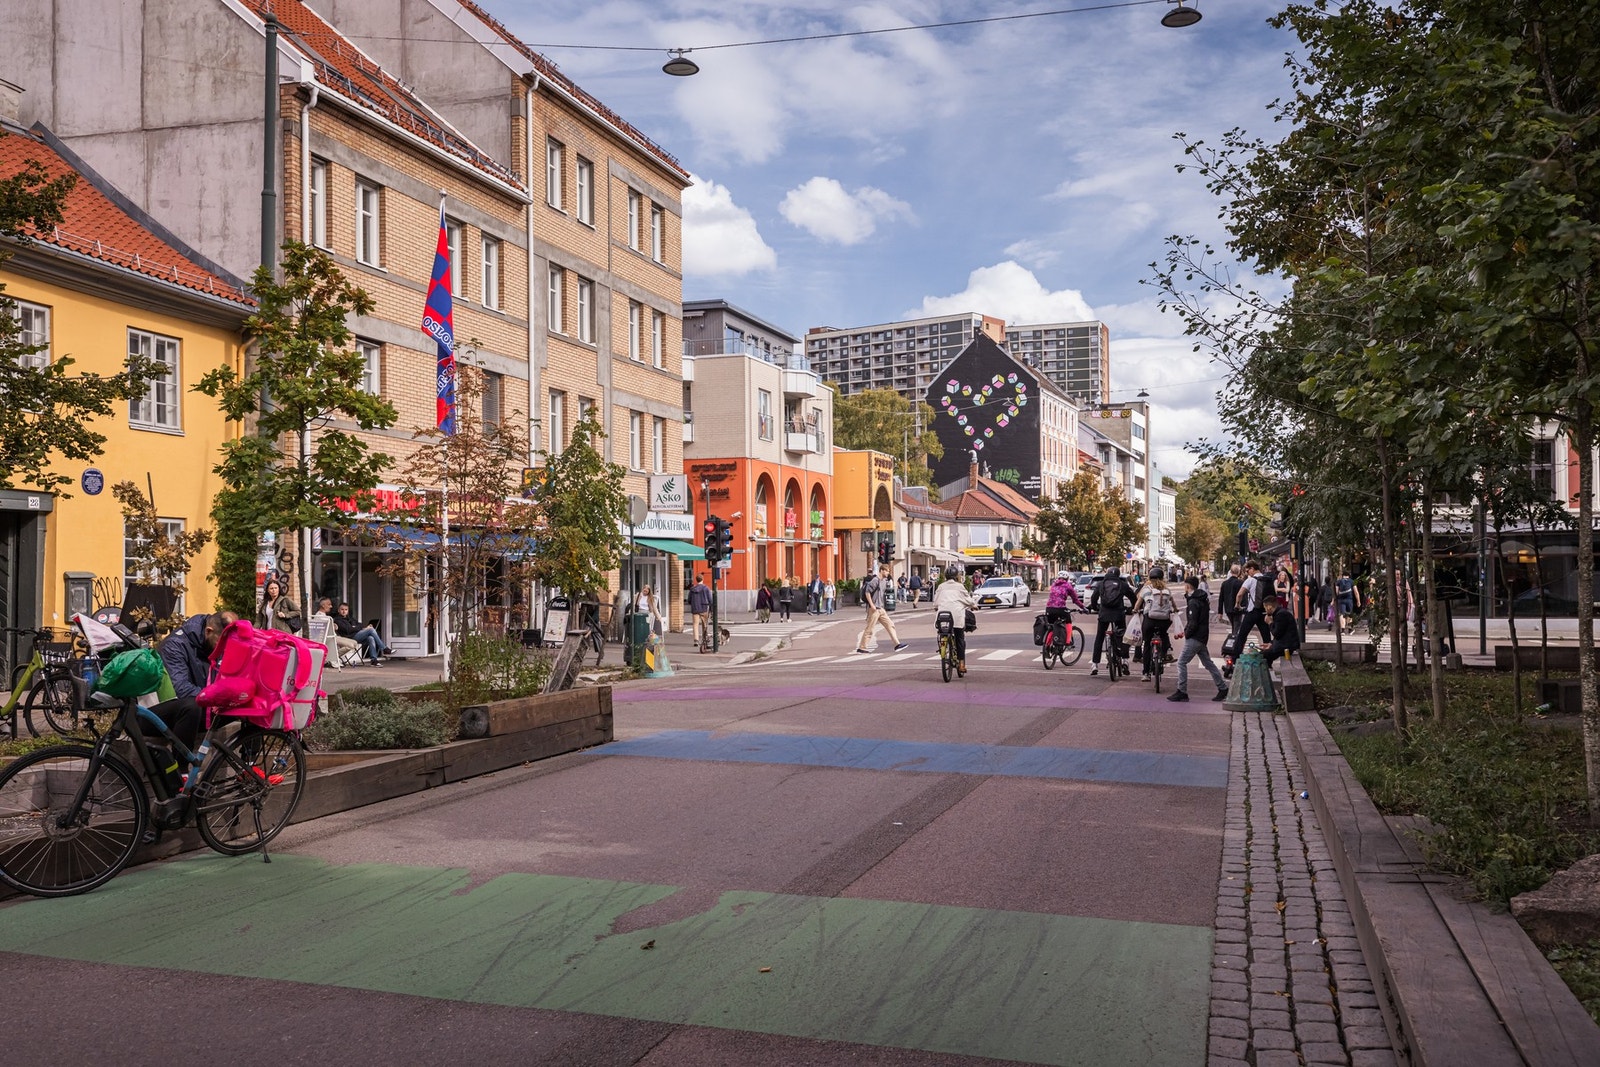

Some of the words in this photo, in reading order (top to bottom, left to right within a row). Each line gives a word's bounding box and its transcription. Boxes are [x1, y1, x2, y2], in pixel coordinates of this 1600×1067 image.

[656, 493, 681, 504] ASKØ
[646, 518, 691, 531] ADVOKATFIRMA
[286, 675, 317, 688] fora
